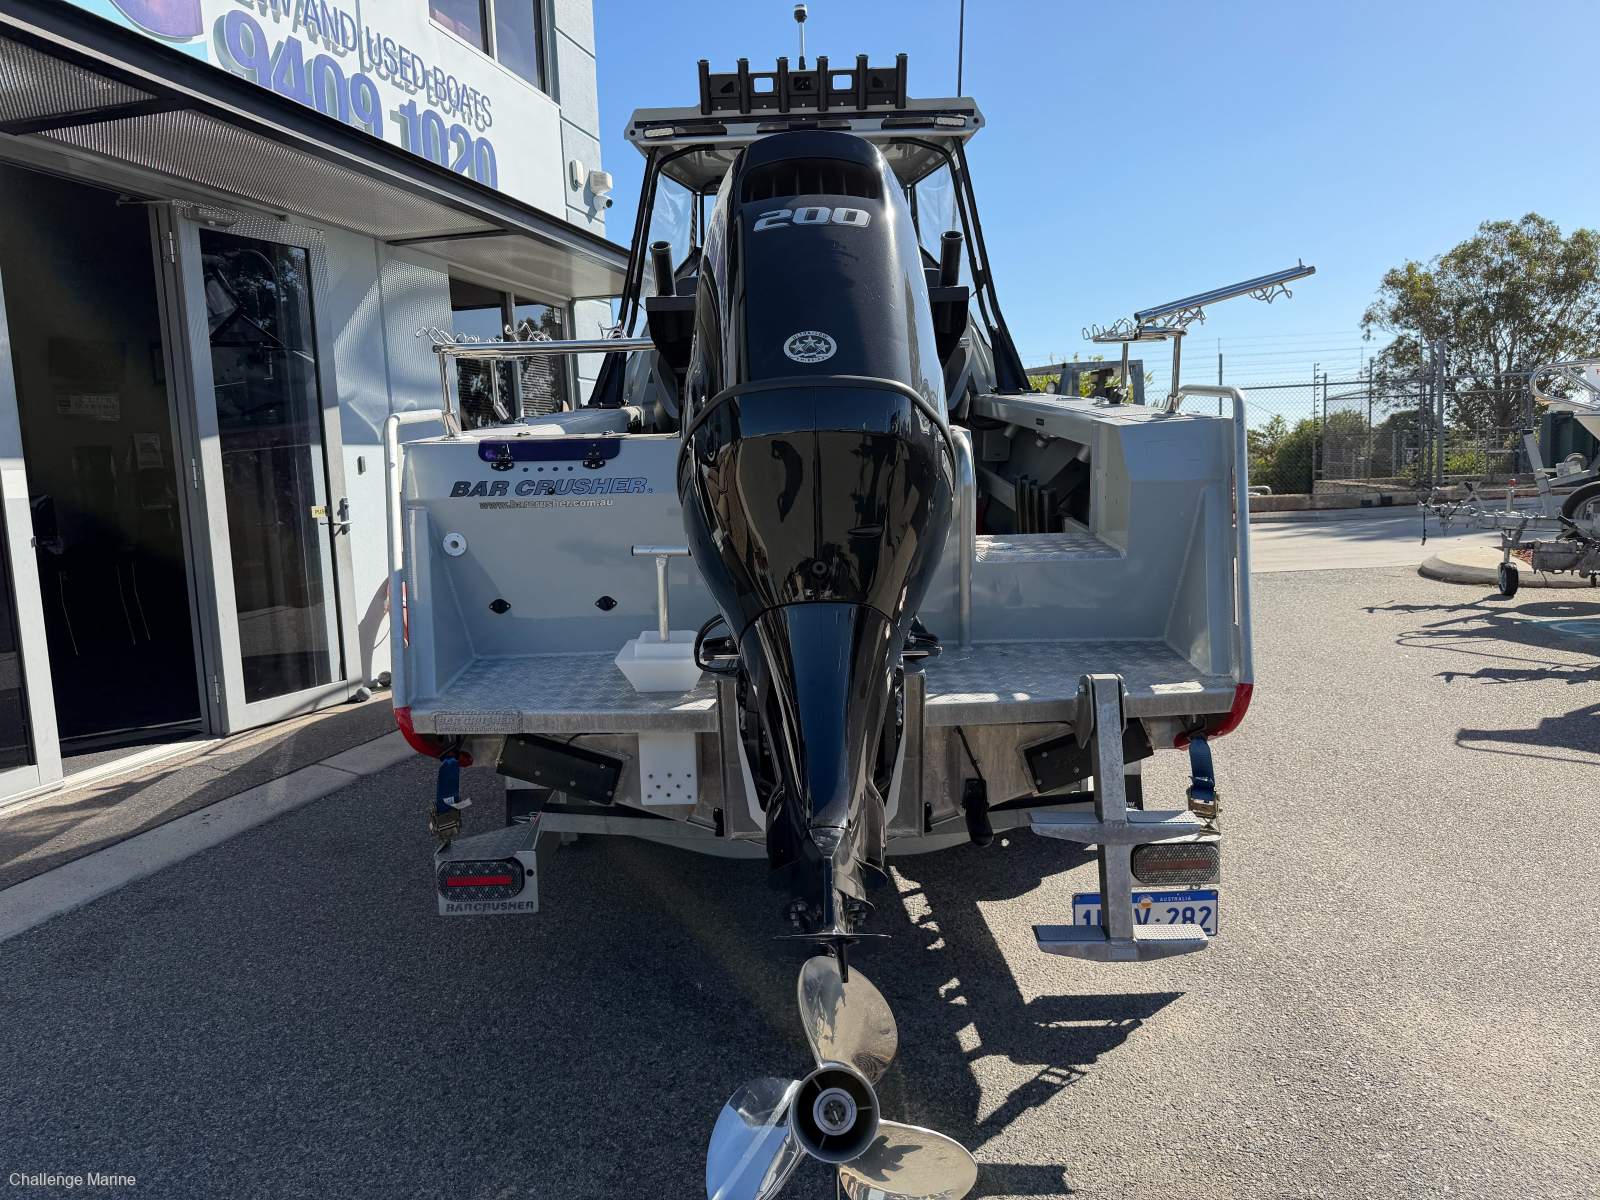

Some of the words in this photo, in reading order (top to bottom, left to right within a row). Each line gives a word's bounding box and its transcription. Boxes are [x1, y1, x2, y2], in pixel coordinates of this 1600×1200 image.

[224, 10, 384, 138] 9409
[303, 0, 357, 51] AND
[366, 25, 426, 90] USED
[434, 65, 492, 128] BOATS
[754, 206, 872, 232] 200
[450, 481, 509, 498] BAR
[479, 499, 613, 510] www.barcrusher.com.au
